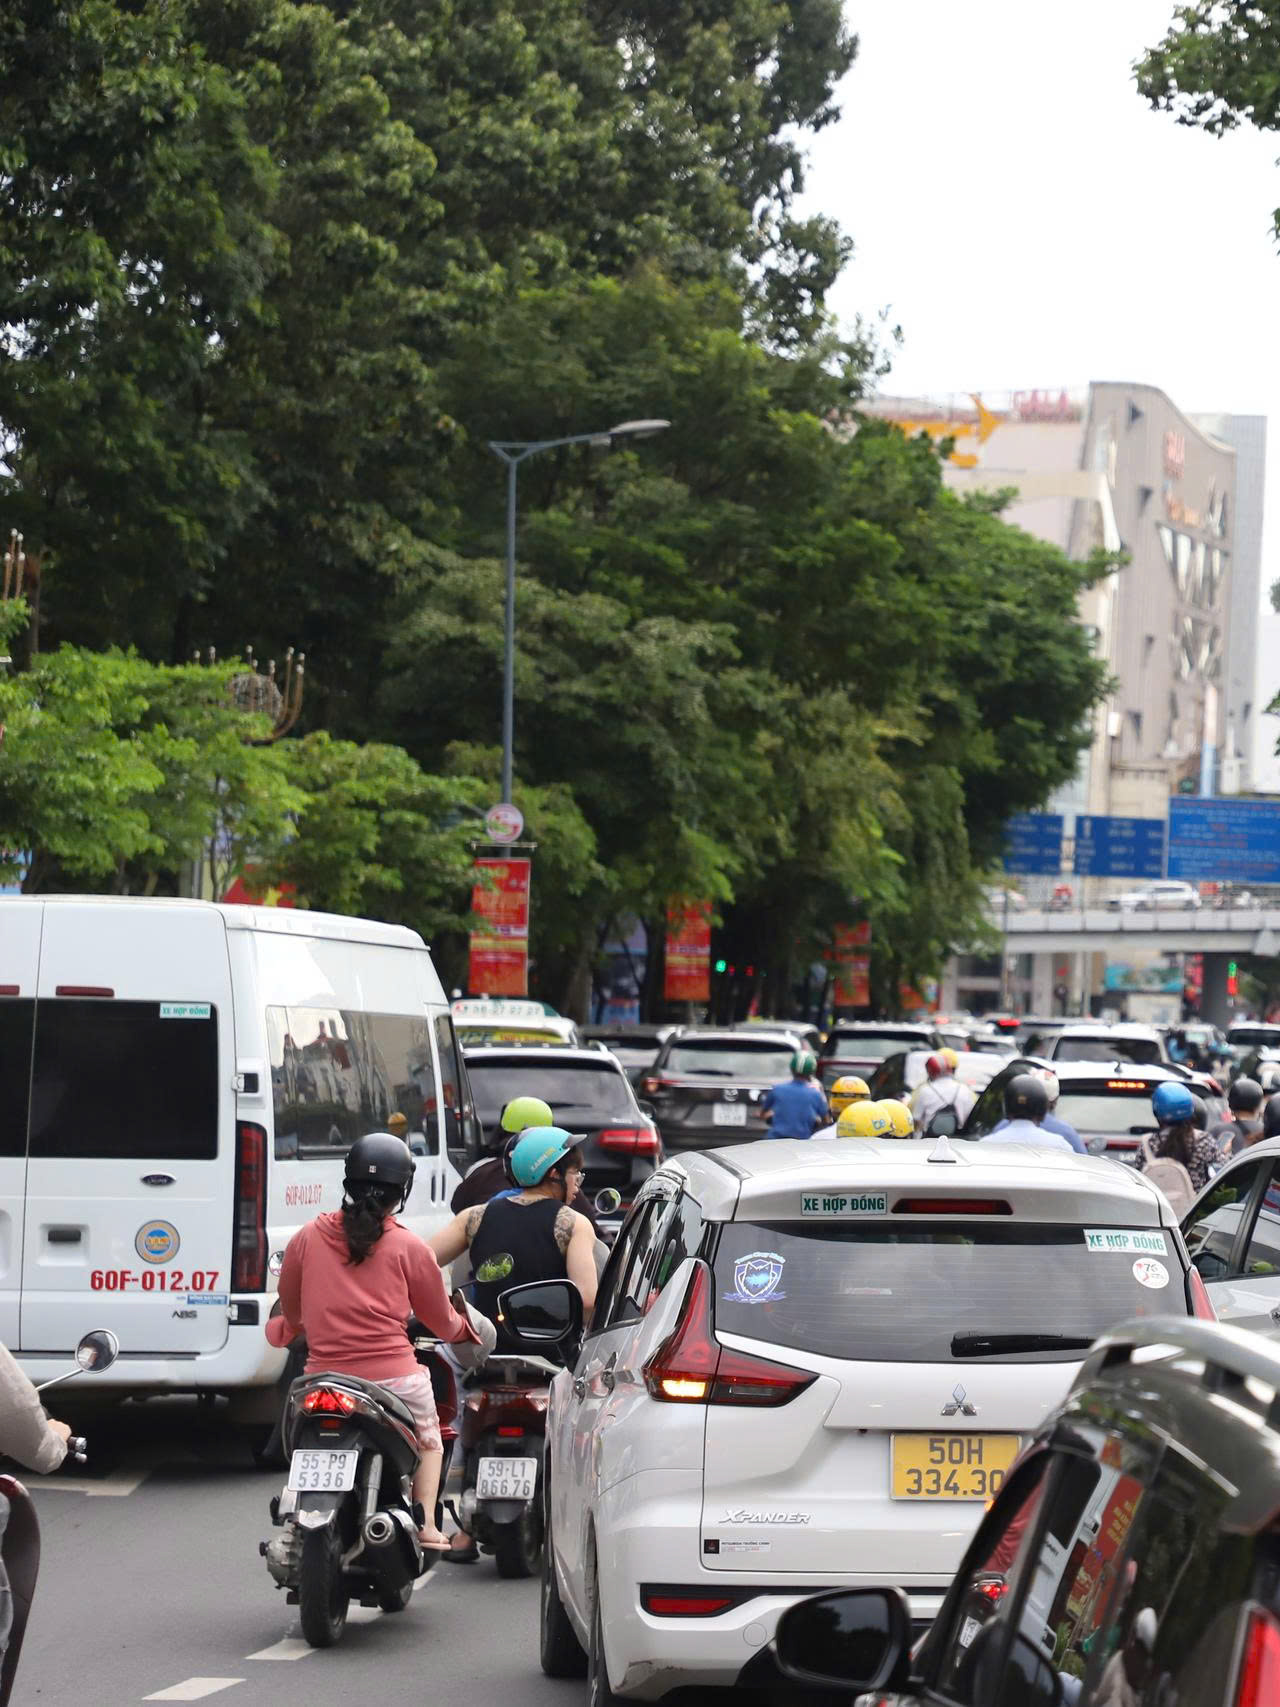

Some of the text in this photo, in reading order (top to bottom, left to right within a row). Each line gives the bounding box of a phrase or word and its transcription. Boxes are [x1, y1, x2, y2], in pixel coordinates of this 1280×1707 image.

[803, 1198, 819, 1211] XE
[822, 1196, 847, 1214] HỢP
[1088, 1234, 1104, 1248] XE
[90, 1269, 220, 1292] 60F-012.07
[172, 1310, 198, 1320] ABS
[928, 1438, 983, 1465] 50H
[297, 1471, 345, 1488] 5336
[480, 1478, 531, 1498] 866.76
[905, 1468, 1008, 1496] 334.30
